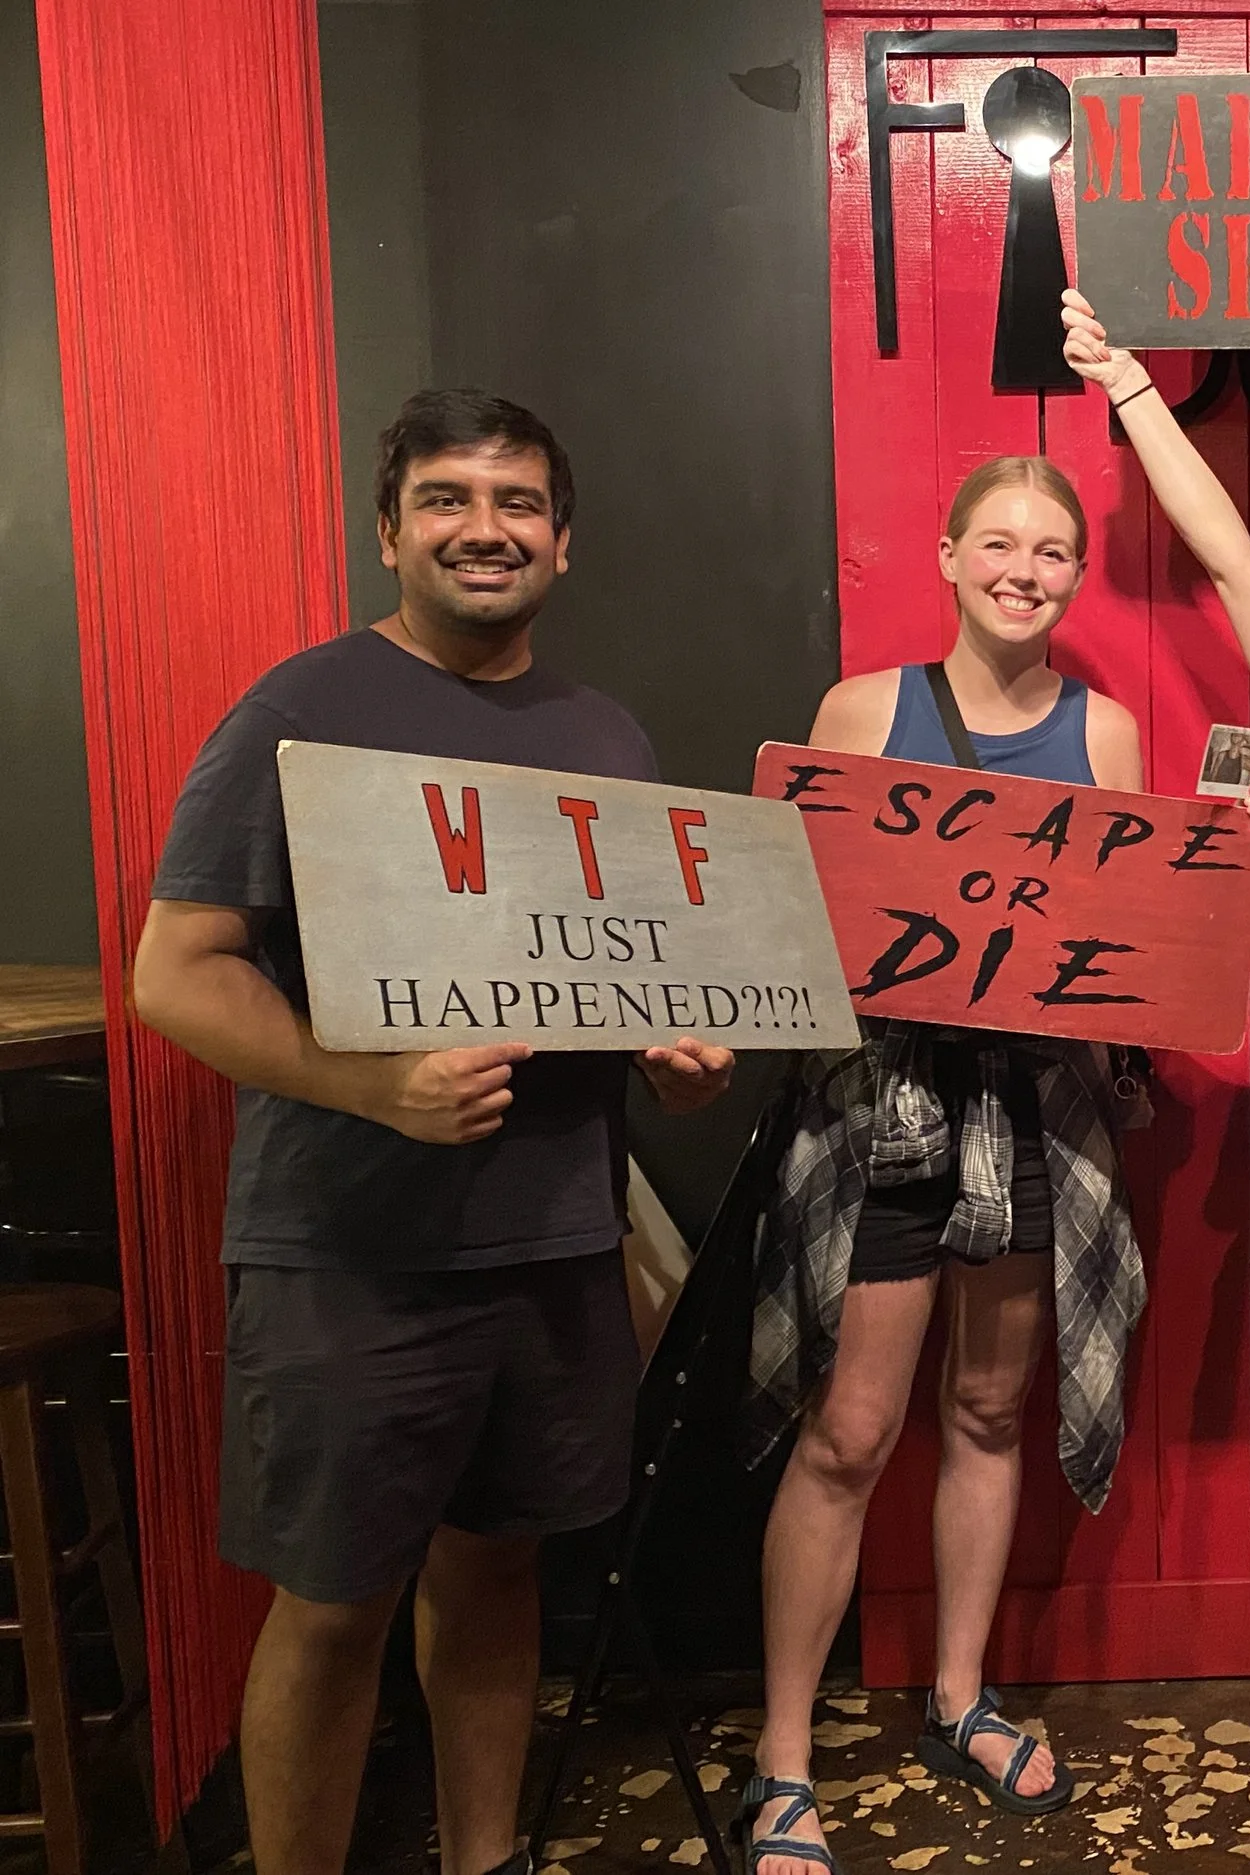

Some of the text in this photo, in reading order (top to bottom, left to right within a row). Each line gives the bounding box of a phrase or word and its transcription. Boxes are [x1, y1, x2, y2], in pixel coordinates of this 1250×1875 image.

[781, 764, 1249, 873] ESCAPE
[959, 870, 1049, 919] OR
[526, 912, 668, 963] JUST
[849, 904, 1157, 1012] DIE
[373, 978, 817, 1030] HAPPENED?!?!
